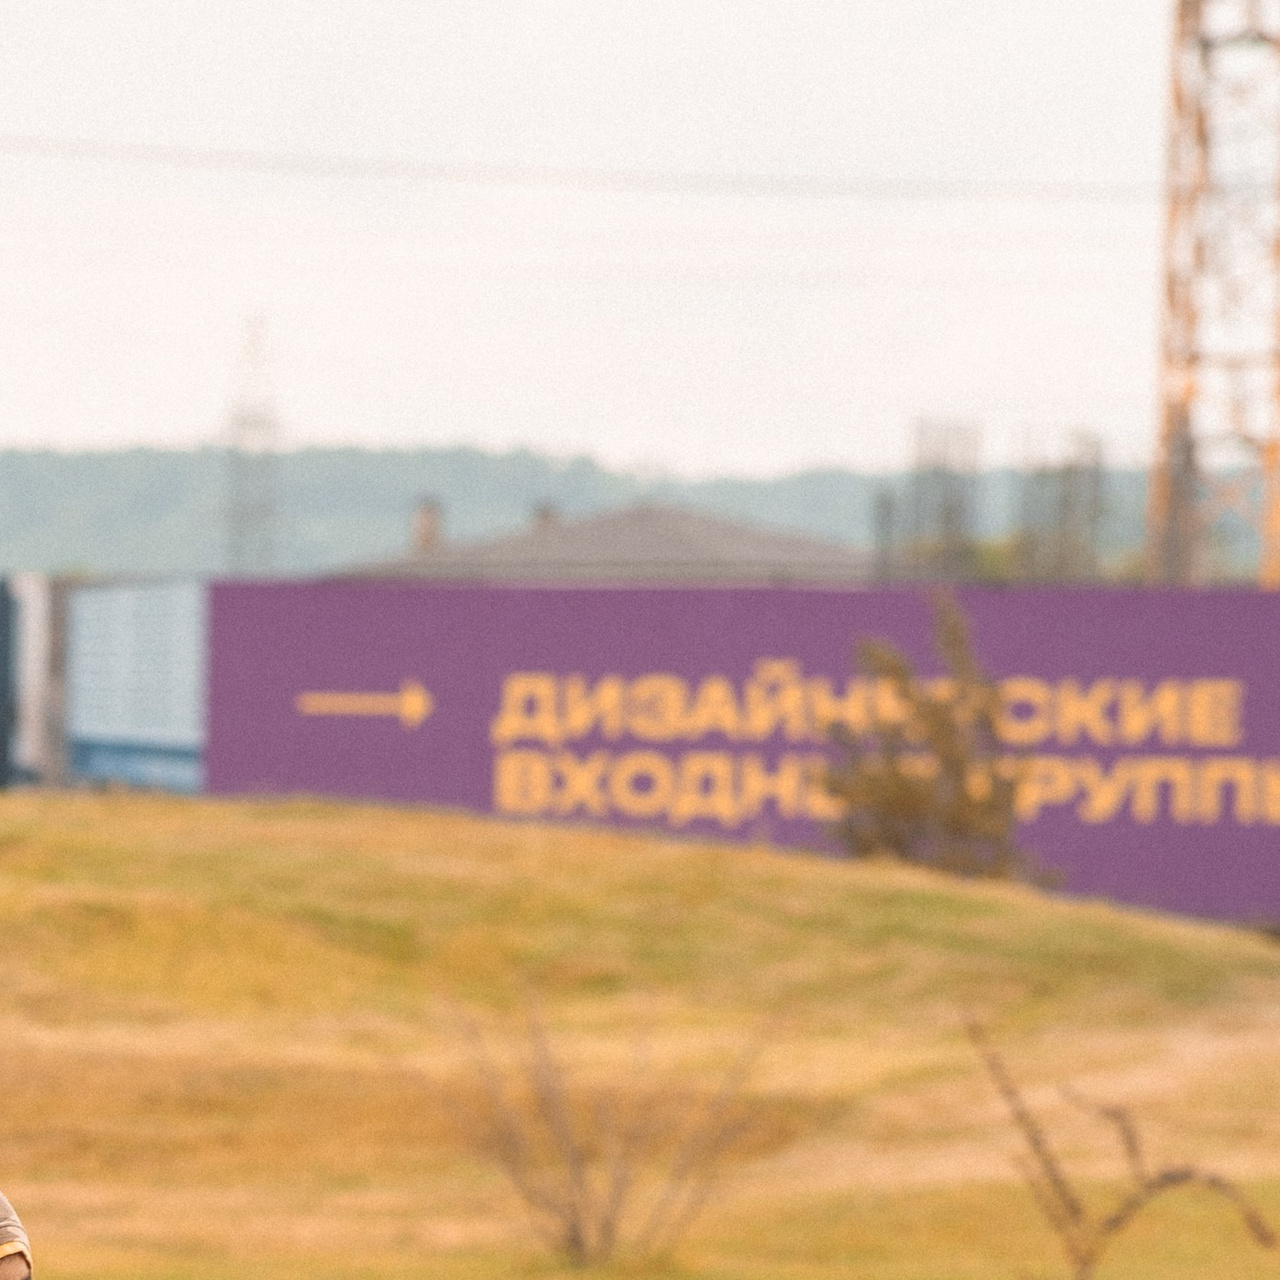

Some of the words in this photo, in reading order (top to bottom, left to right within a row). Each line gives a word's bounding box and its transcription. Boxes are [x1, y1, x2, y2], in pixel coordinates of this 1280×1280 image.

[490, 657, 1244, 749] ДИЗАЙНСКИЕ
[494, 750, 940, 830] ВХОДН
[963, 755, 1280, 828] РУПП
